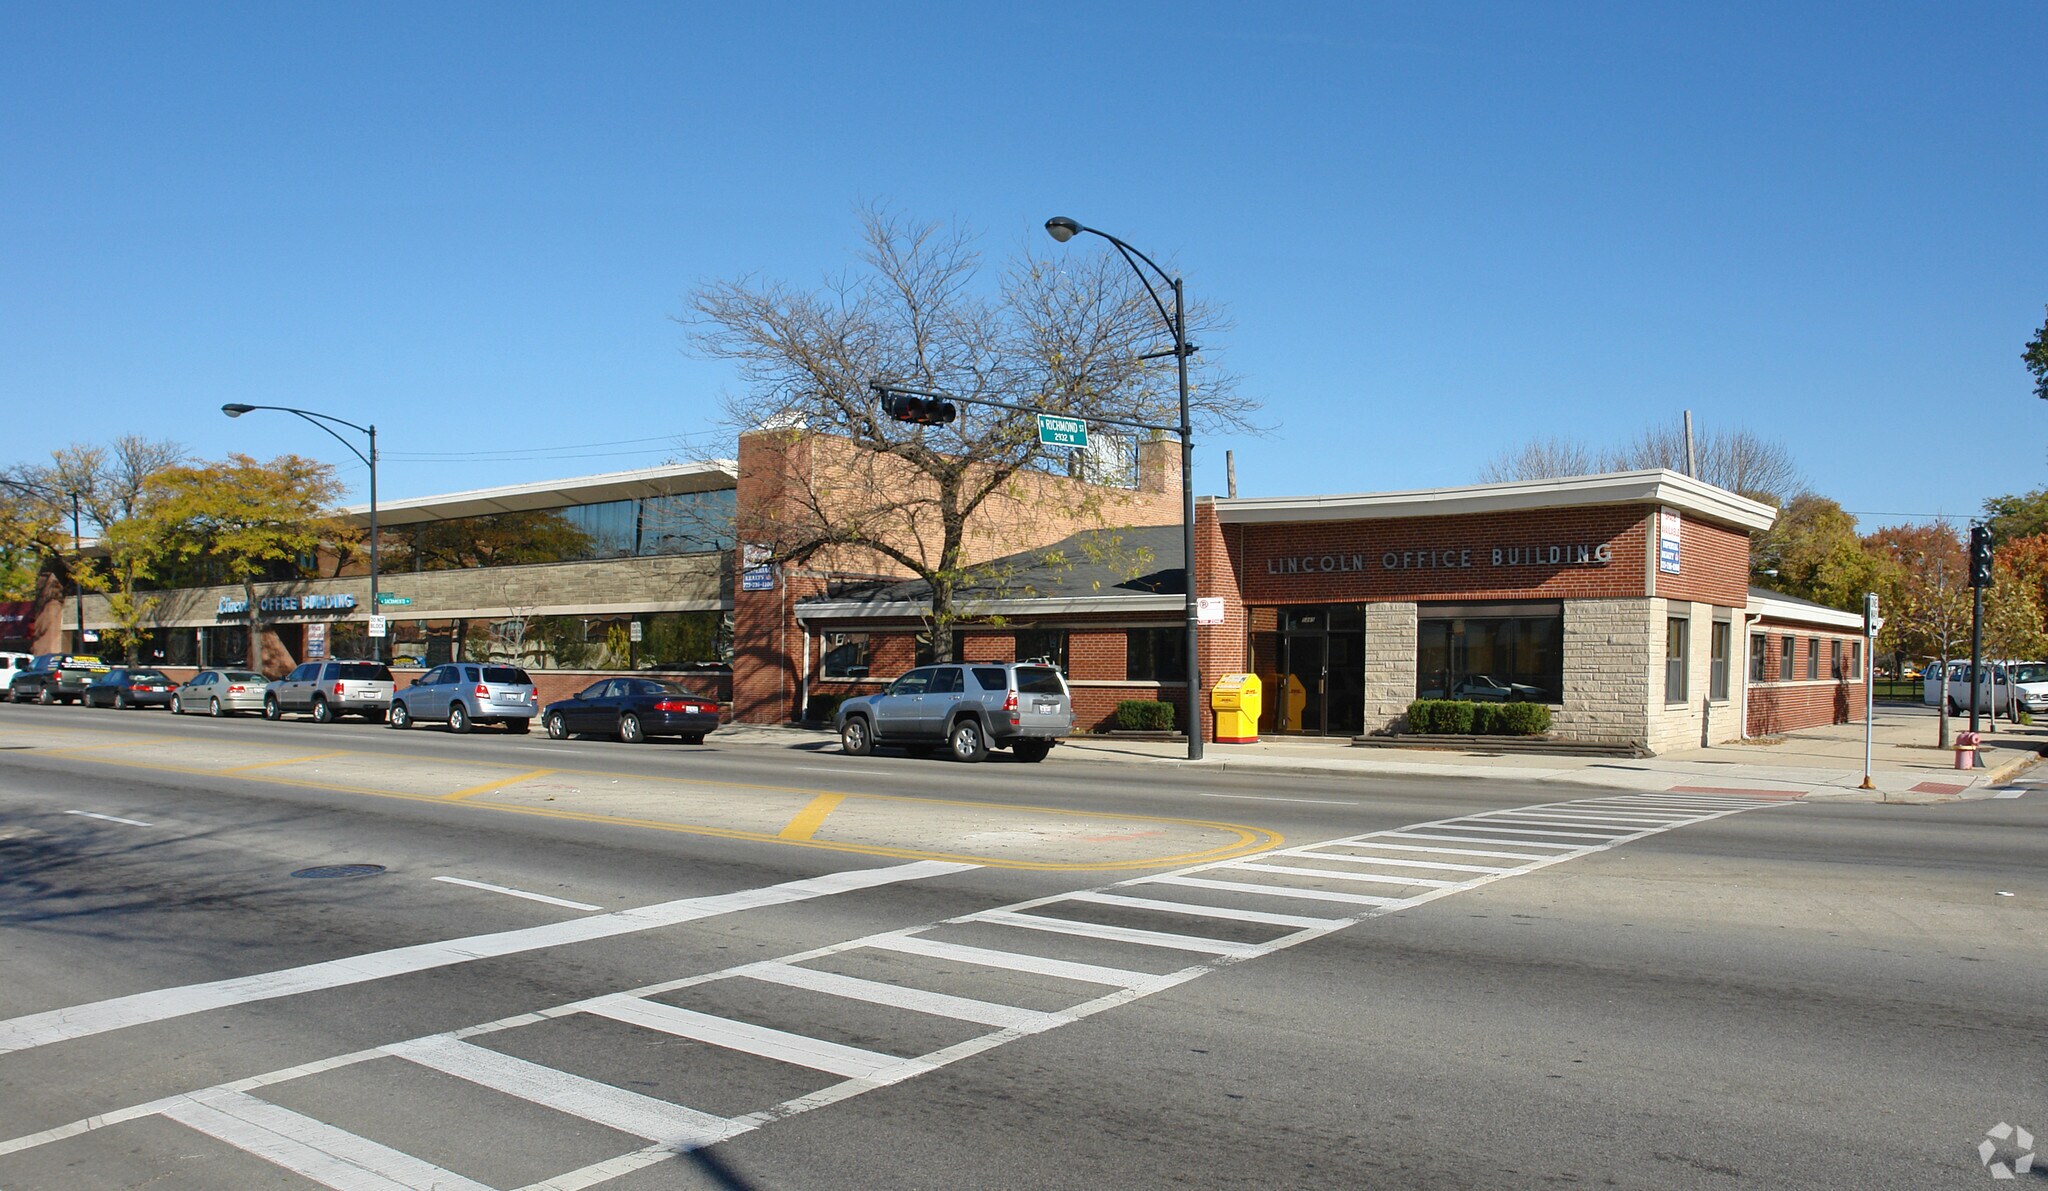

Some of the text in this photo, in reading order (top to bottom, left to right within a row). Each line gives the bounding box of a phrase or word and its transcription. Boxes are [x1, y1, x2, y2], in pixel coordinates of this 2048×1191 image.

[1040, 419, 1084, 433] N RICHMOND ST
[1054, 433, 1075, 443] 2932 W
[1267, 543, 1612, 575] LINCOLN OFFICE BUILDING
[260, 597, 299, 612] OFFICE
[301, 593, 355, 610] BUILDING
